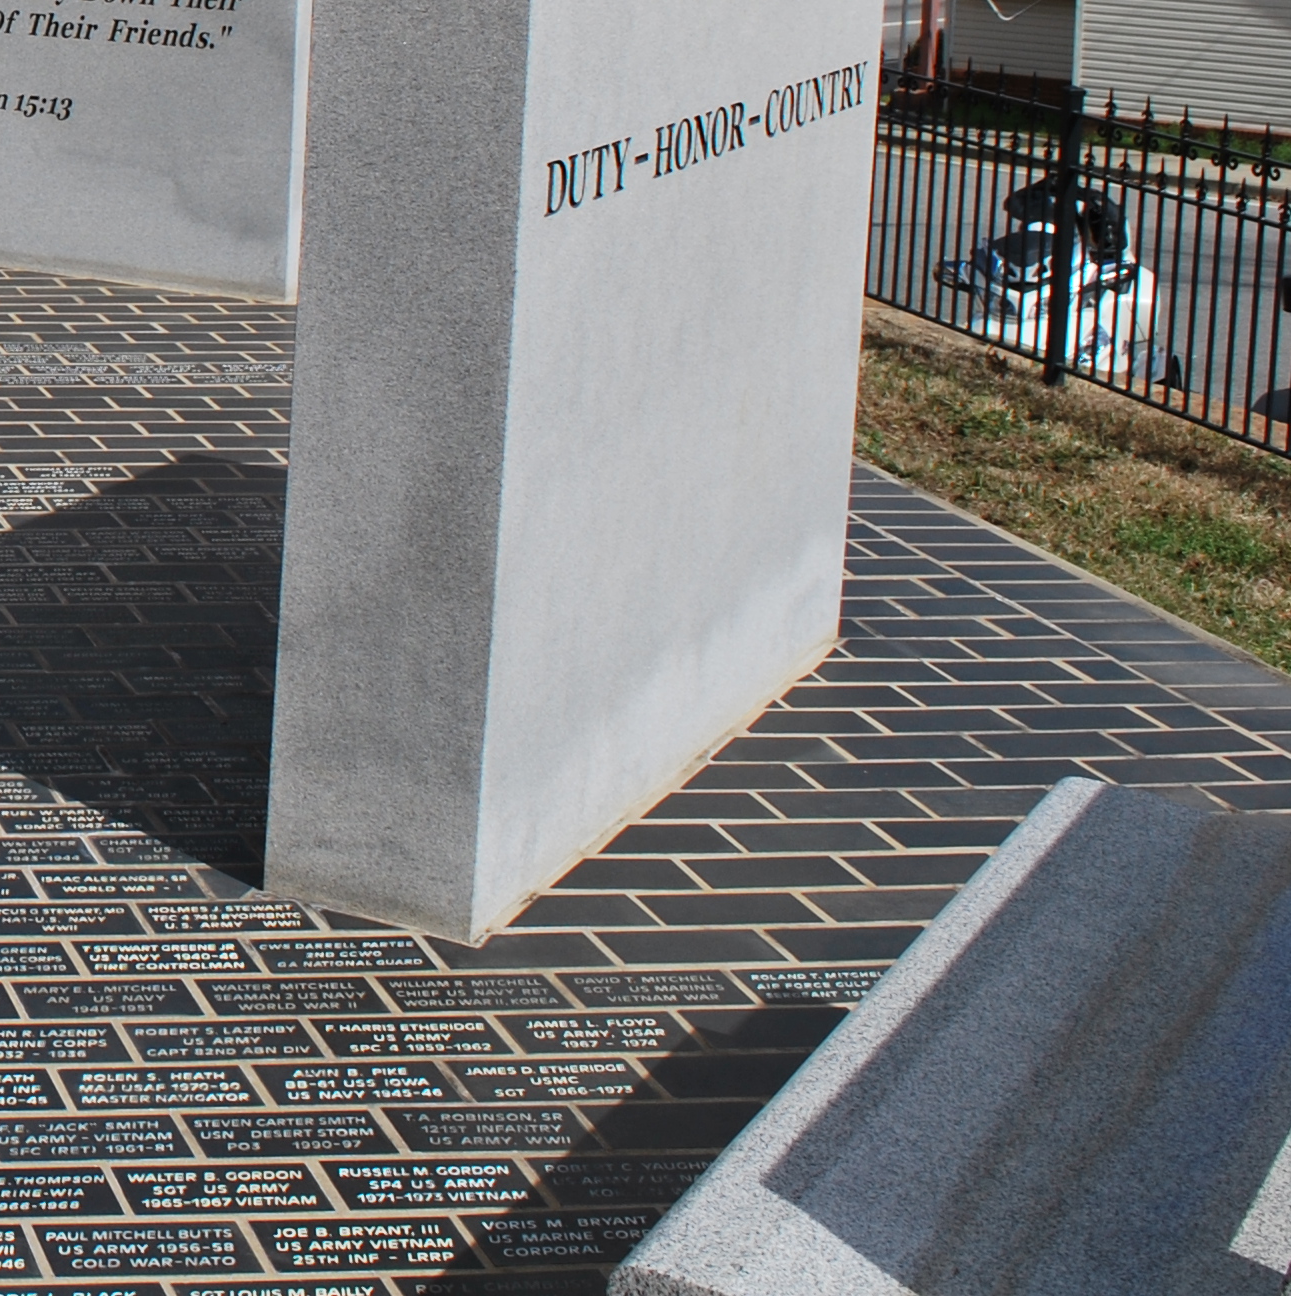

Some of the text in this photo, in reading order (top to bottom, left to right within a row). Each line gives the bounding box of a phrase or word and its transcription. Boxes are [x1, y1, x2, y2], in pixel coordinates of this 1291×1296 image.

[29, 12, 98, 40] Their
[108, 19, 233, 50] Friends."
[14, 94, 73, 121] 15:13
[127, 1170, 302, 1183] WALTER B. GORDON
[153, 1183, 289, 1195] SGT US ARMY
[142, 1195, 317, 1208] 1965-1967 VIETNAM
